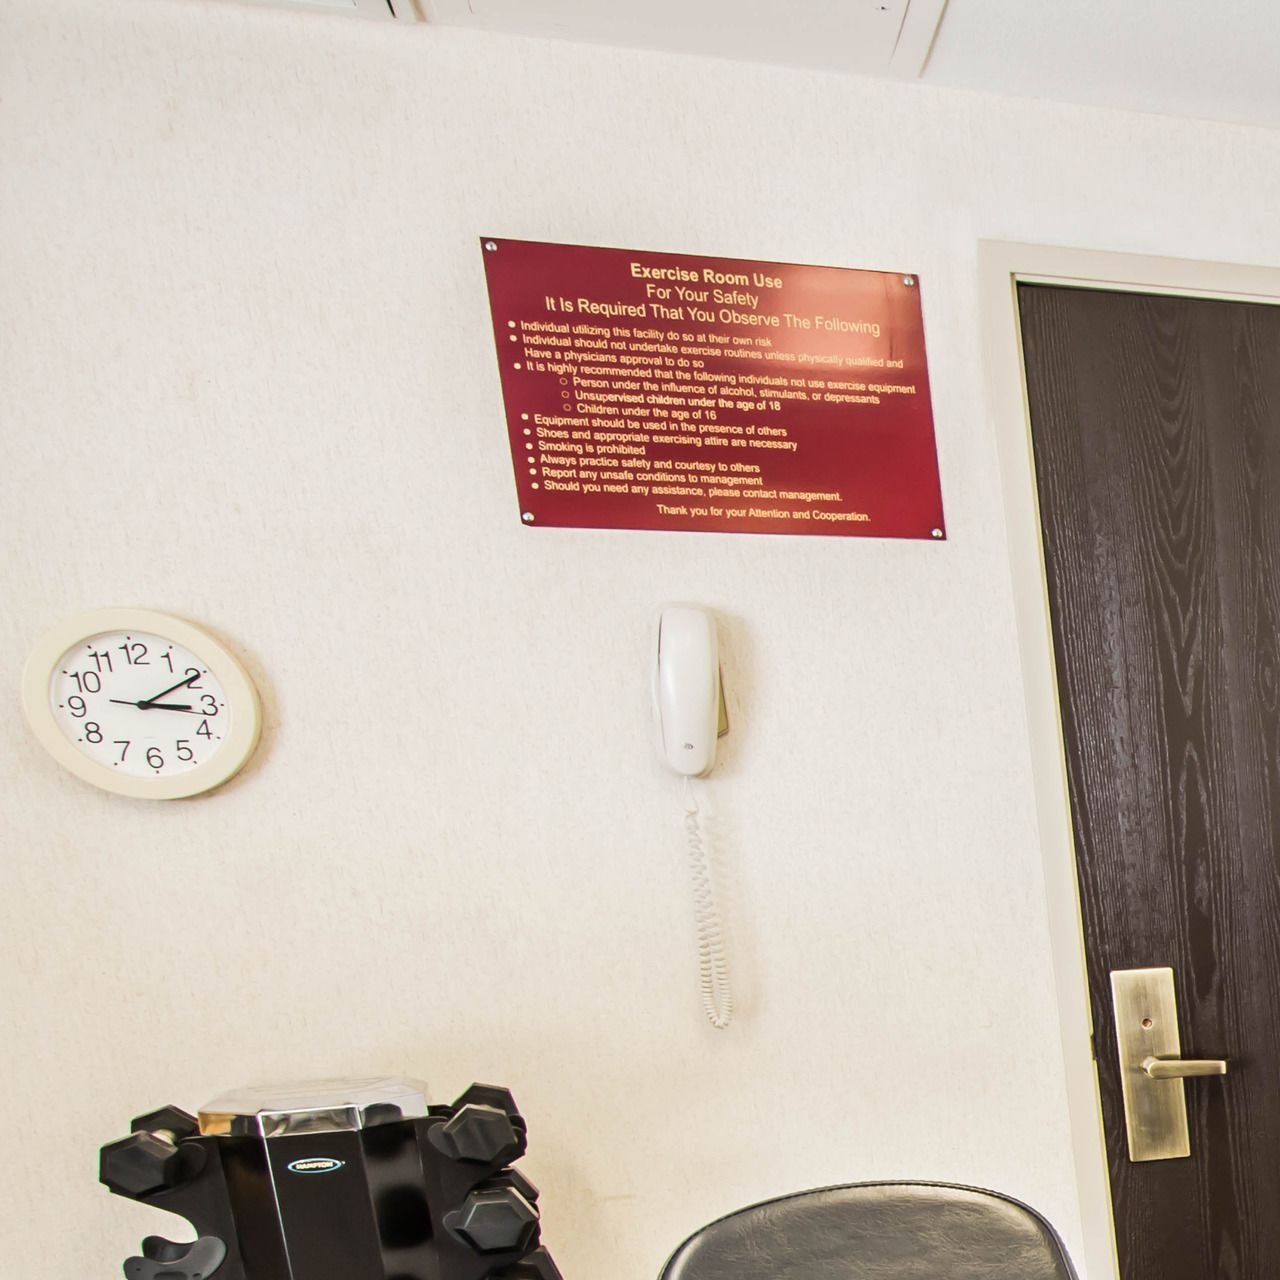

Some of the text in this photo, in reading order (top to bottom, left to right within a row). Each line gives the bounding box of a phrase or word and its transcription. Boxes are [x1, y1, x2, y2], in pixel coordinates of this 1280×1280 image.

[631, 263, 783, 288] Exercise Room Use
[646, 284, 758, 309] For Your Safety
[546, 296, 880, 338] It Is Required That You Observe The Following
[521, 321, 772, 347] Individual utilizing this facility do so at their own risk
[523, 335, 903, 369] Individual should not undertake exercise routines unless physically qualified and
[525, 348, 552, 358] Have
[564, 352, 617, 363] physicians
[620, 354, 662, 366] approval
[665, 358, 674, 366] to
[678, 358, 689, 367] do
[692, 360, 704, 368] so
[527, 361, 916, 394] It is highly recommended that the following individuals not use exercise equipment
[573, 378, 609, 388] Person
[612, 380, 640, 390] under
[643, 382, 659, 392] the
[661, 383, 705, 394] influence
[708, 384, 718, 394] of
[720, 386, 757, 398] alcohol,
[759, 389, 809, 400] stimulants,
[824, 392, 880, 404] depressants
[575, 391, 780, 411] Unsupervised children under the age of 18
[577, 403, 716, 420] Children under the age of 16
[535, 414, 787, 436] Equipment should be used in the presence of others
[537, 428, 797, 451] Shoes and appropriate exercising attire are necessary
[538, 441, 646, 456] Smoking is prohibited
[540, 454, 760, 473] Always practice safety and courtesy to others
[542, 467, 762, 486] Report any unsafe conditions to management
[544, 480, 843, 502] Should you need any assistance, please contact management.
[657, 504, 871, 523] Thank you for your Attention and Cooperation.
[88, 651, 112, 672] 11
[118, 643, 150, 664] 12
[161, 652, 173, 673] 1
[69, 671, 101, 693] 10
[185, 668, 203, 689] 2
[68, 696, 86, 718] 9
[200, 695, 218, 716] 3
[84, 722, 103, 743] 8
[196, 720, 213, 740] 4
[113, 741, 130, 761] 7
[146, 747, 164, 768] 6
[176, 740, 193, 761] 5
